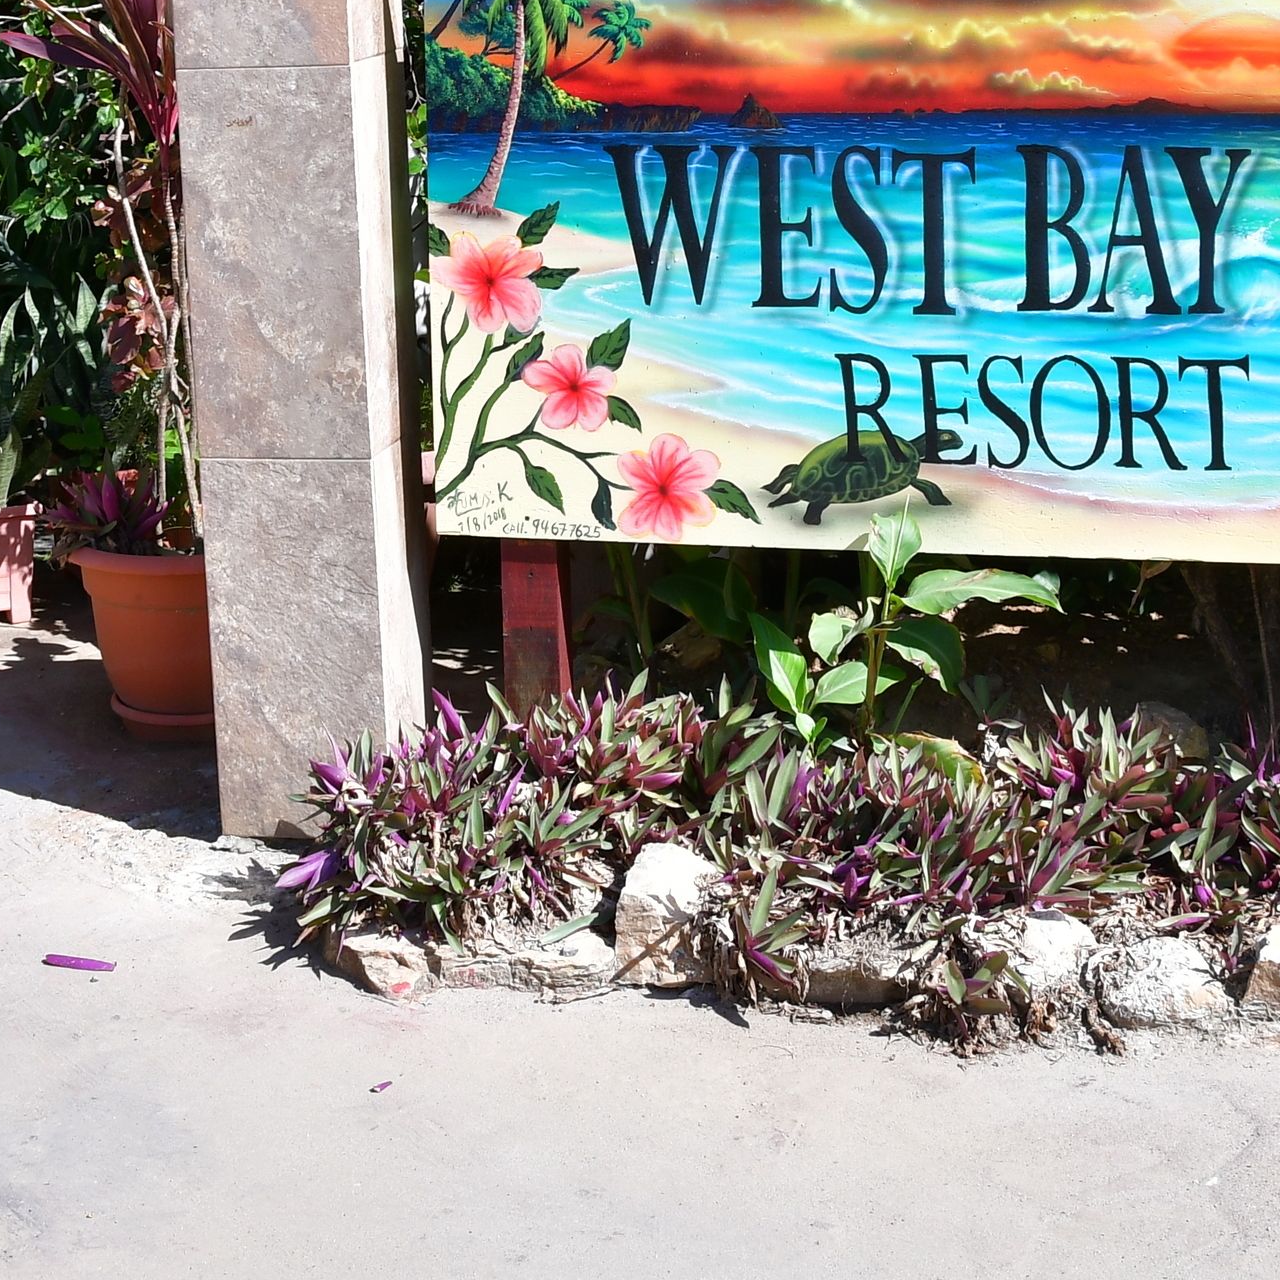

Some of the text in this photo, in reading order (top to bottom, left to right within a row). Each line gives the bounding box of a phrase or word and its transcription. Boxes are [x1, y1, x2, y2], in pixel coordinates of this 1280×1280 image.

[602, 144, 976, 316] WEST
[1016, 144, 1254, 316] BAY
[834, 352, 1250, 472] RESORT
